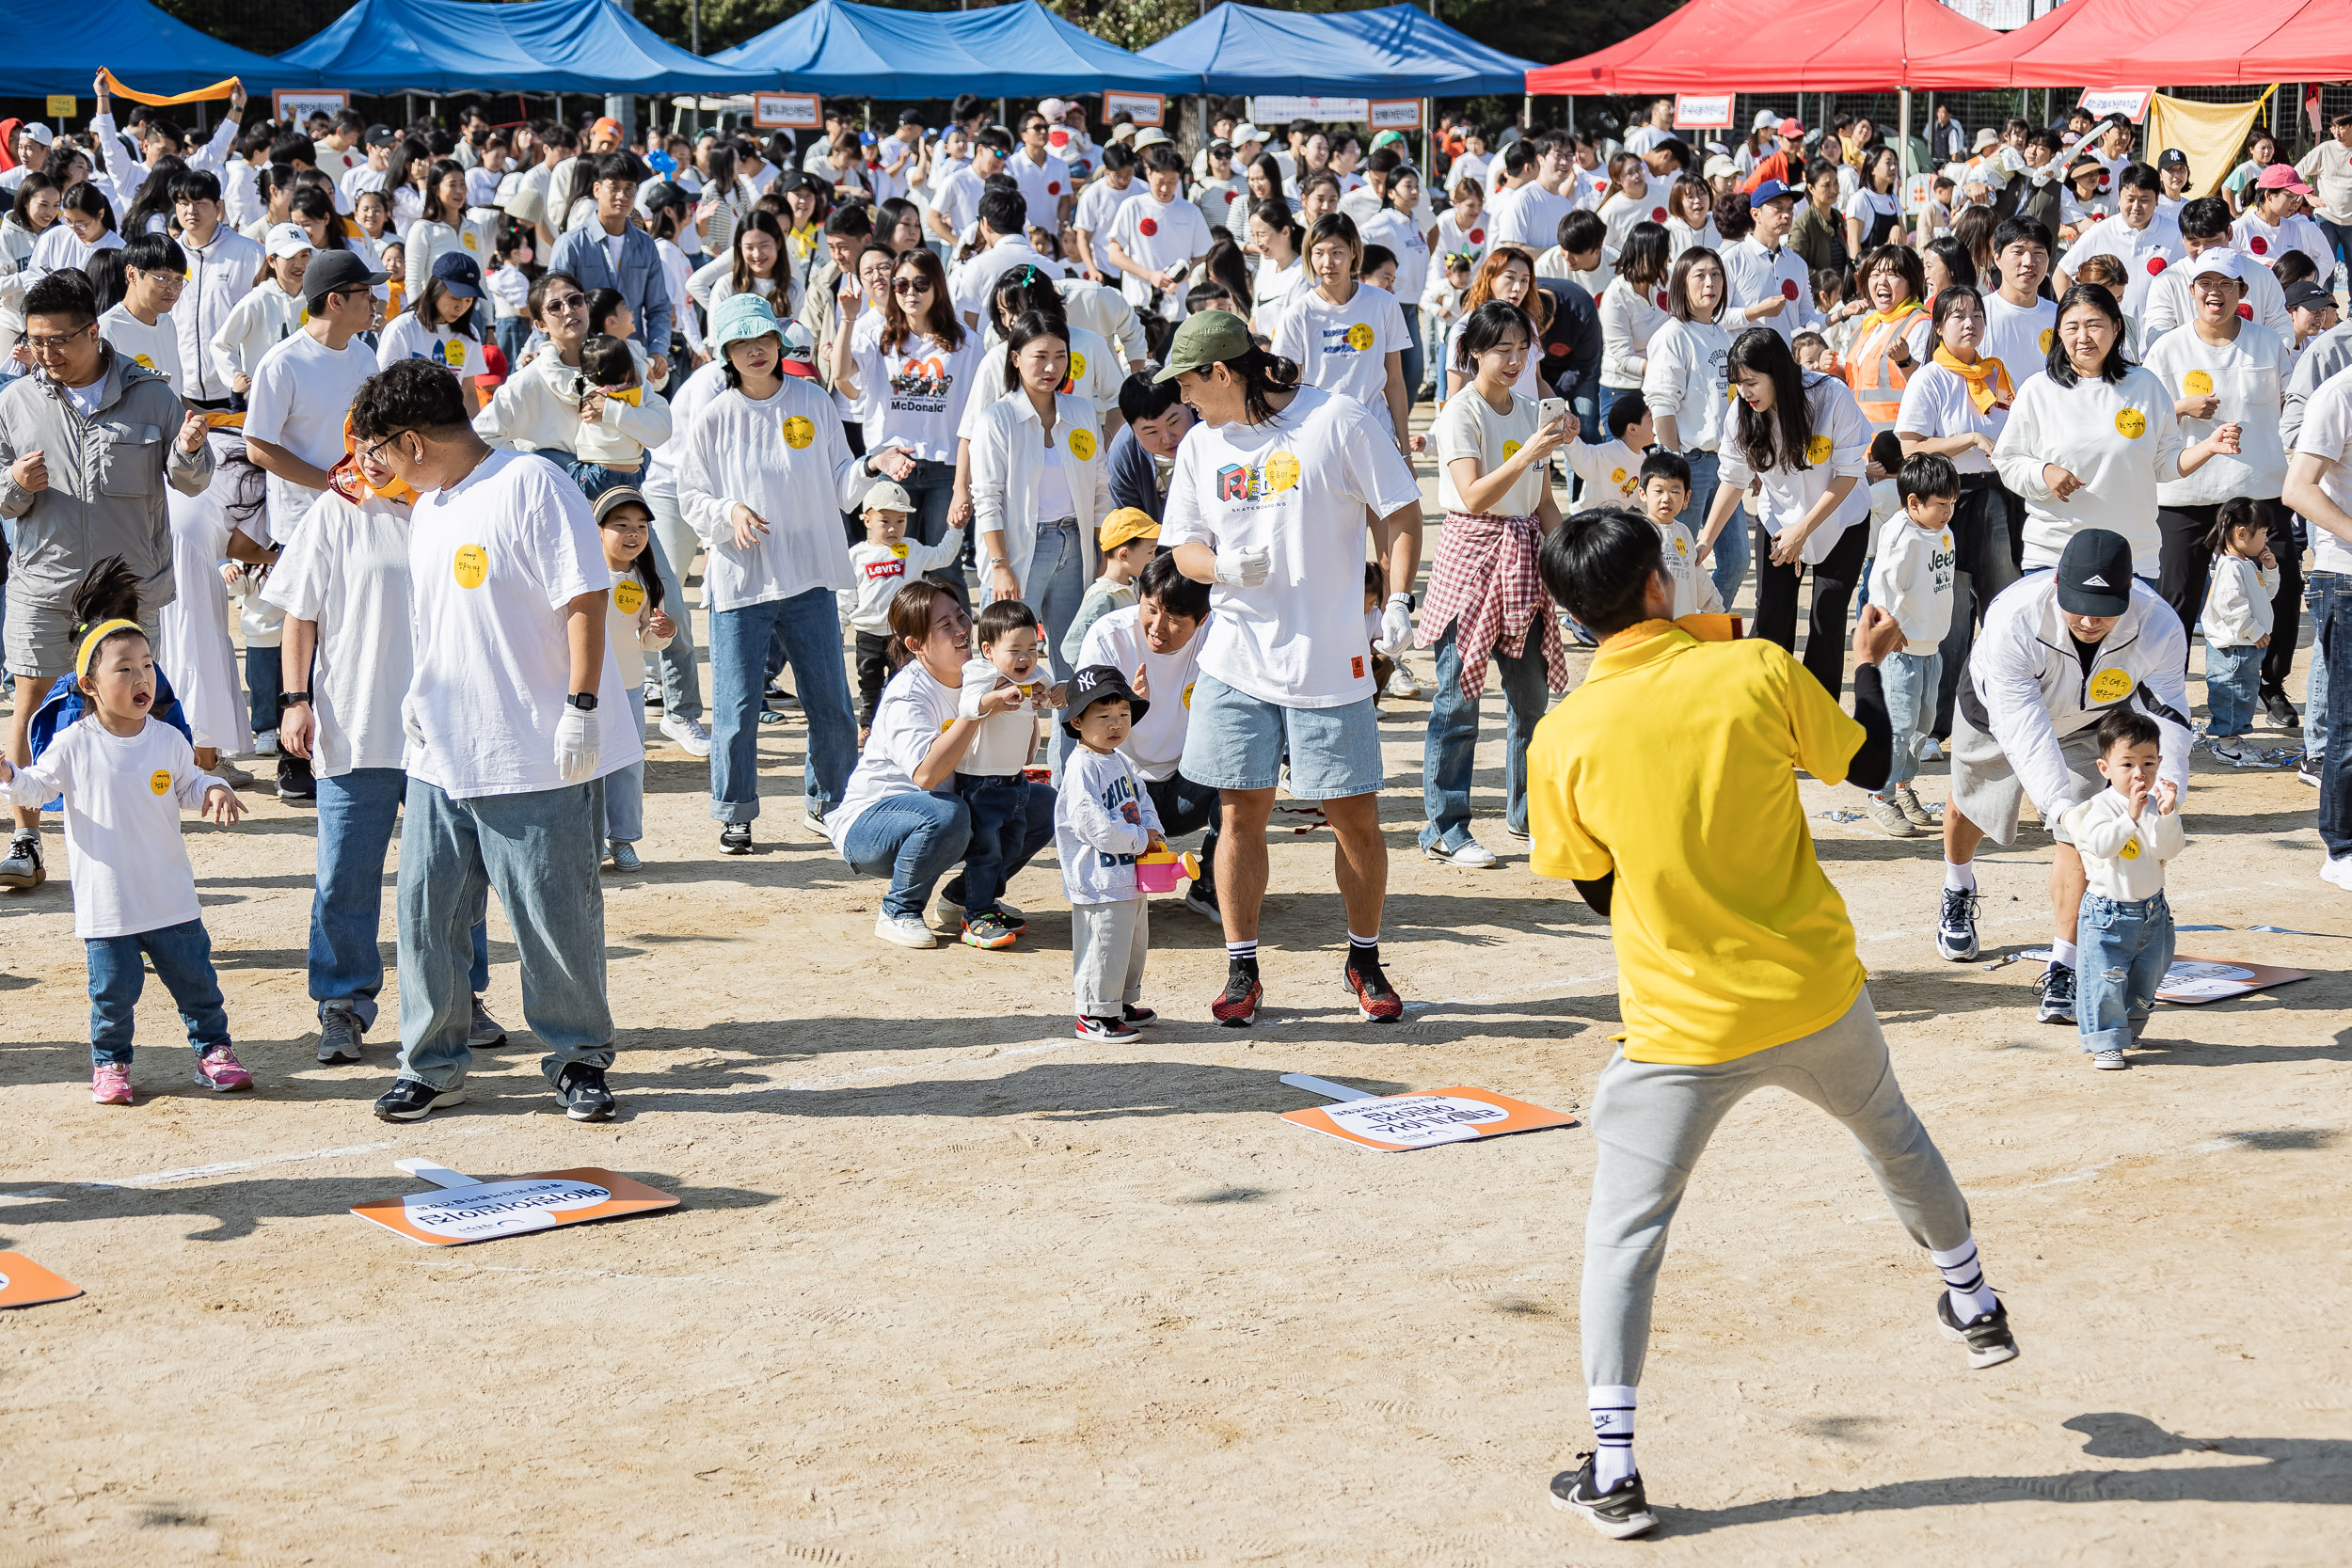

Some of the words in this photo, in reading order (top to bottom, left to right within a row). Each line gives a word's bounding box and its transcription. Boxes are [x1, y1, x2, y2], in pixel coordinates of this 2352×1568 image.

[2169, 150, 2180, 161] NY
[1776, 180, 1788, 191] LA
[289, 230, 300, 239] NY
[1232, 501, 1287, 513] SKATEBOARDING
[1928, 548, 1955, 572] Jeep
[1077, 671, 1097, 692] NY
[1361, 1104, 1456, 1123] 어린이집
[1367, 1109, 1503, 1133] 리틀지니어스
[417, 1188, 610, 1227] 예아랑어린이집
[1596, 1414, 1612, 1423] NIKE
